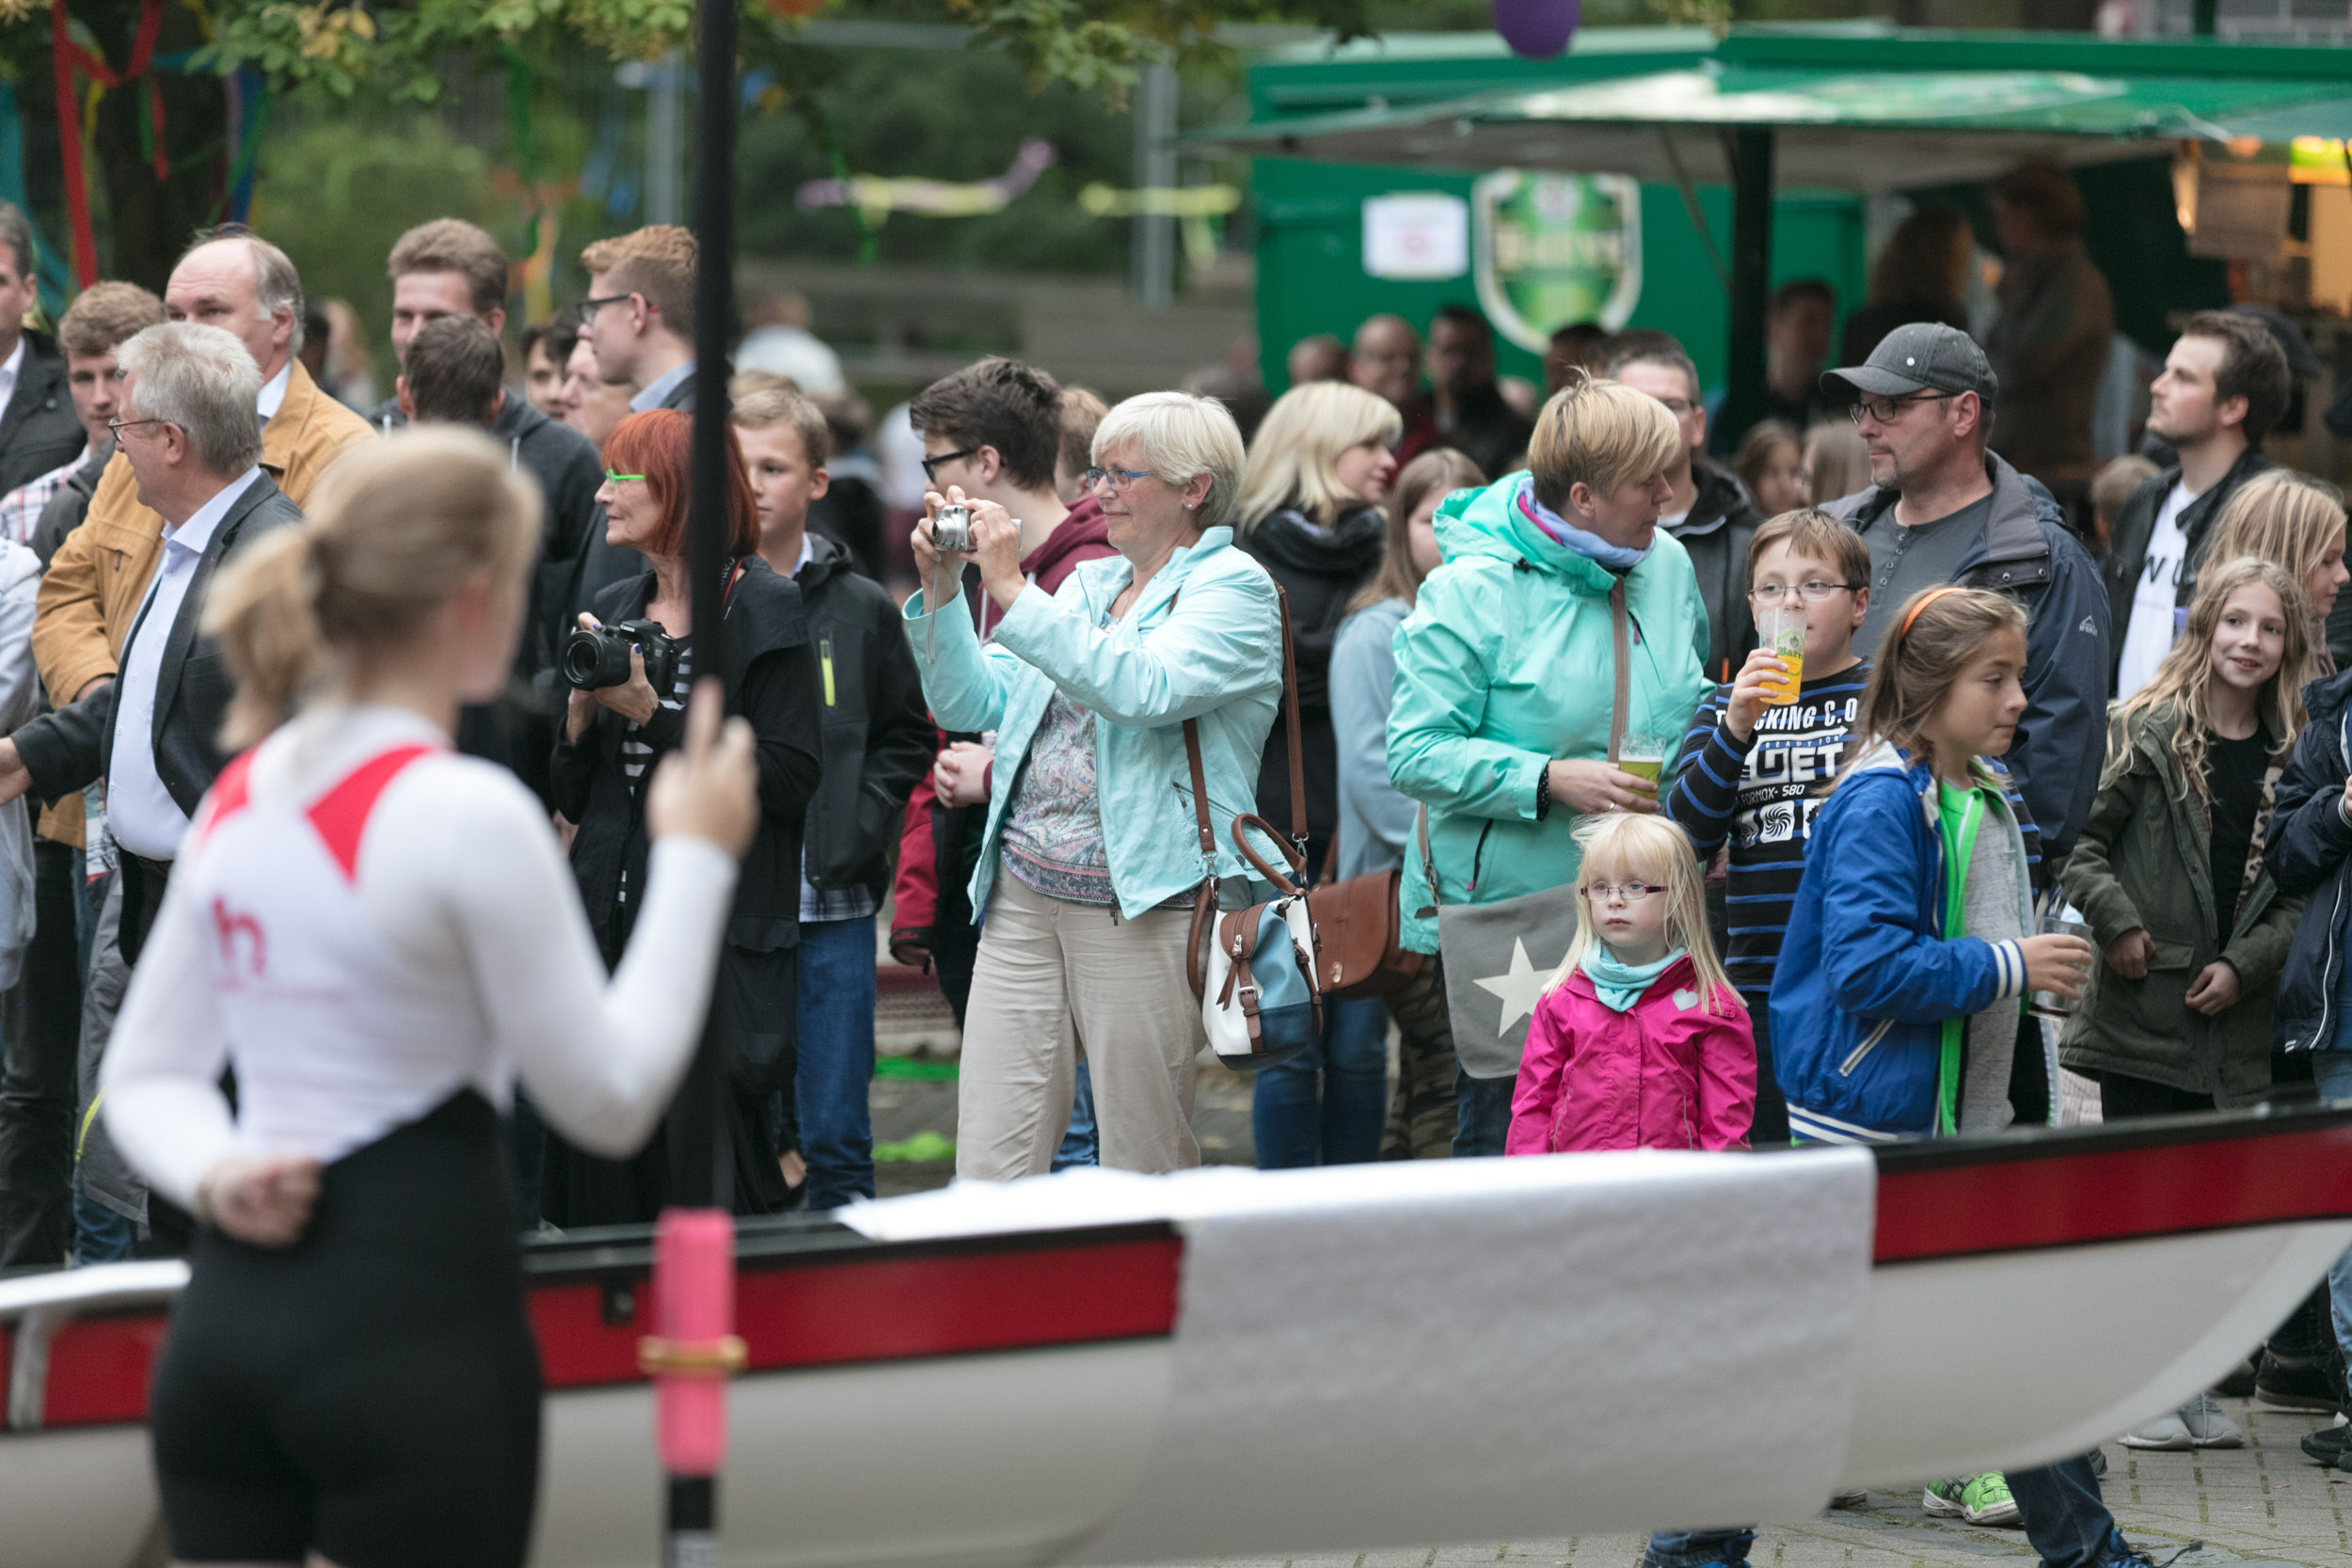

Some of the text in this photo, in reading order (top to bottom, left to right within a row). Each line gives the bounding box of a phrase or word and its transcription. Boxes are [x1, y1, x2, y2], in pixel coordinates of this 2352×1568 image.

[1715, 705, 1818, 731] TCKING
[1765, 734, 1840, 749] READY FOR
